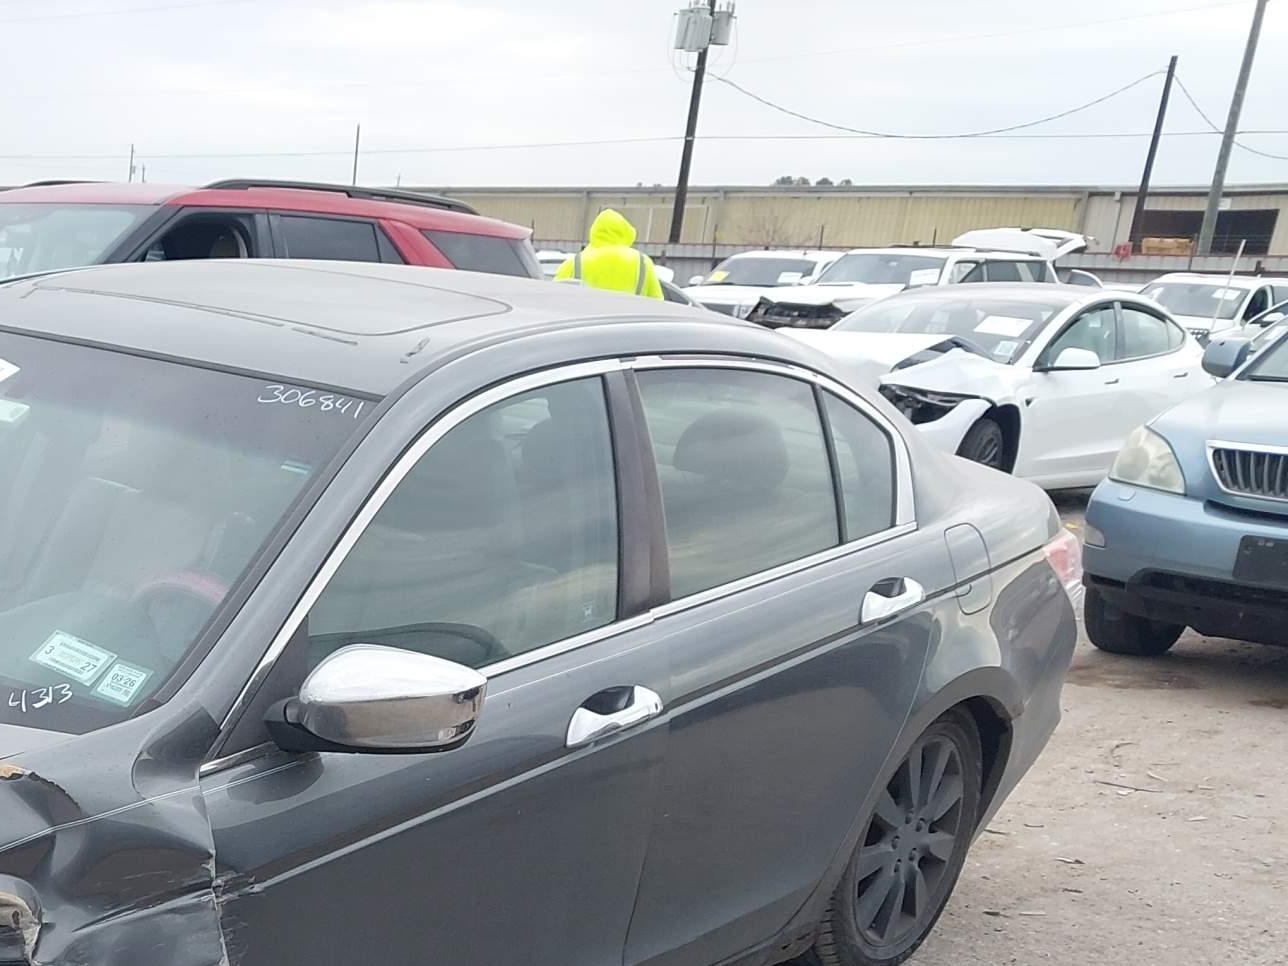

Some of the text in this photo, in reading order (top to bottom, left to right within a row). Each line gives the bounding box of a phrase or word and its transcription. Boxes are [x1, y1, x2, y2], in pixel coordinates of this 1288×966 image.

[257, 384, 365, 419] 306841
[45, 645, 55, 655] 3
[80, 661, 97, 673] 27
[8, 683, 73, 712] 4313
